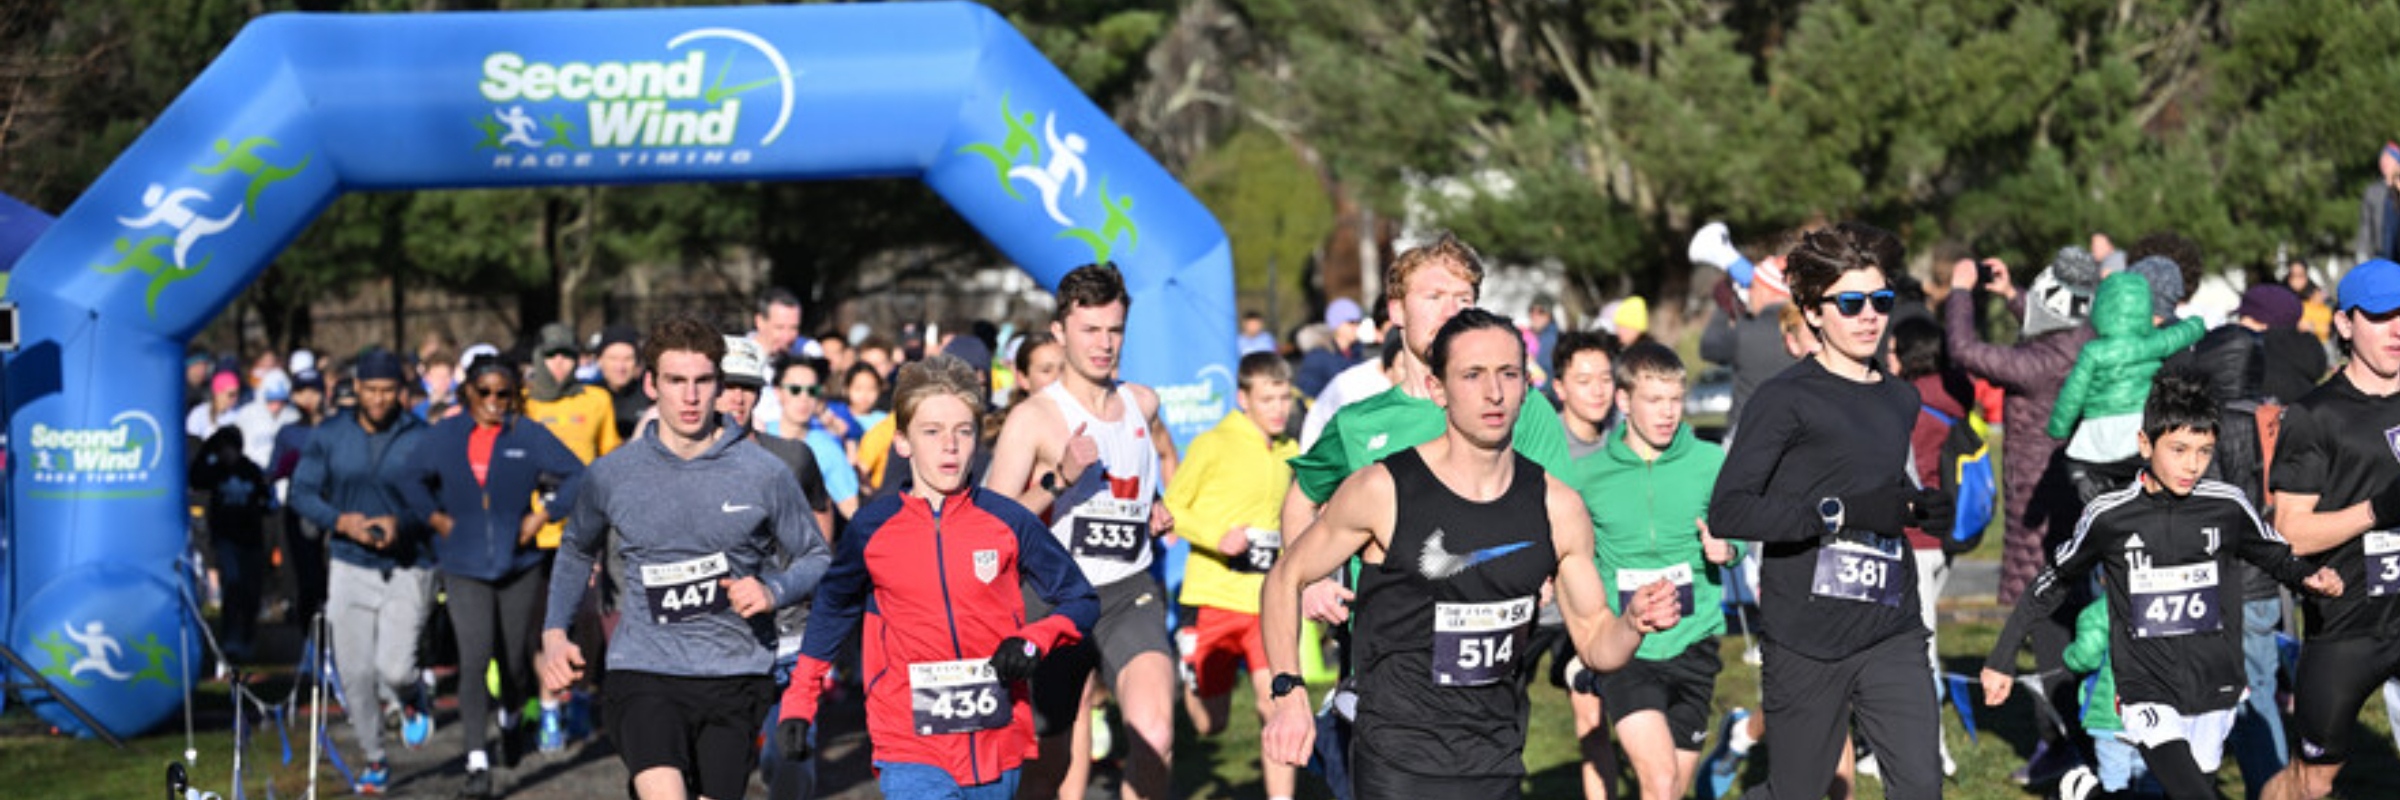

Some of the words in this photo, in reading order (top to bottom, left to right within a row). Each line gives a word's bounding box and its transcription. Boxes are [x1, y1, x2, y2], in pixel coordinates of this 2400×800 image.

[480, 51, 706, 101] Second
[587, 98, 741, 147] Wind
[493, 152, 593, 168] RACE
[617, 149, 752, 165] TIMING
[31, 423, 129, 448] Second
[73, 446, 143, 472] Wind
[1085, 522, 1137, 549] 333
[1836, 555, 1888, 590] 381
[2193, 569, 2210, 583] 5K
[661, 579, 717, 611] 447
[2145, 593, 2207, 622] 476
[1511, 603, 1529, 622] 5K
[1457, 633, 1514, 669] 514
[931, 687, 998, 719] 436
